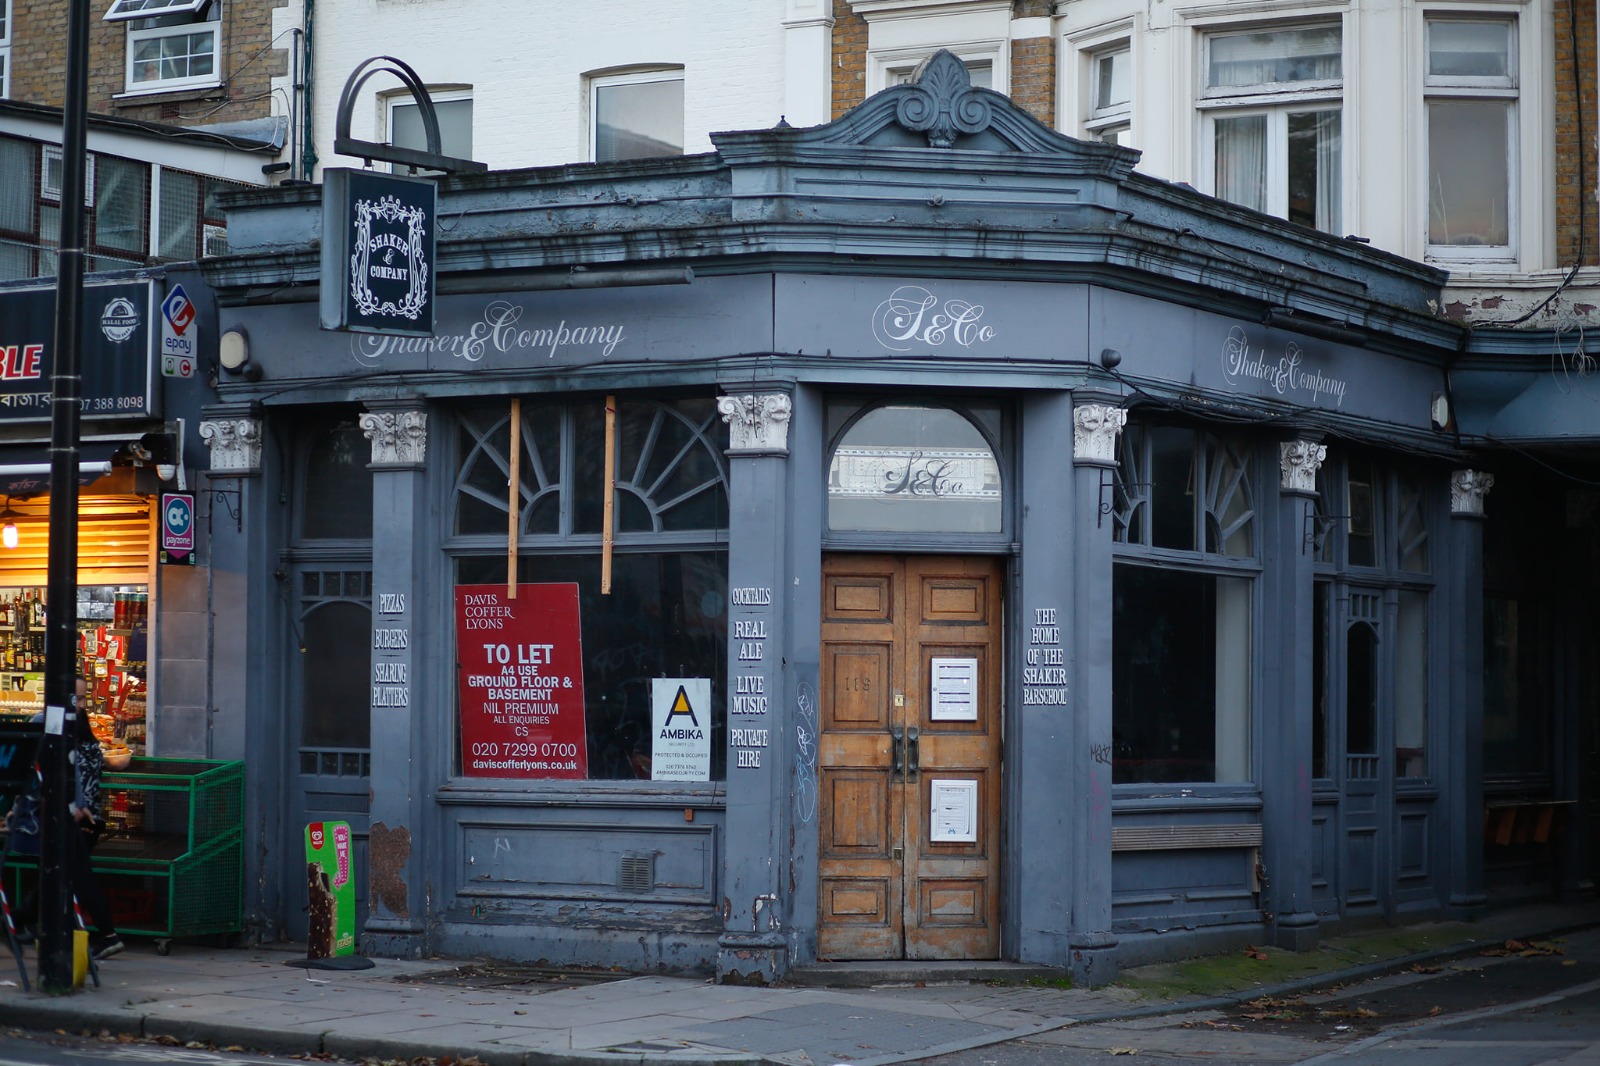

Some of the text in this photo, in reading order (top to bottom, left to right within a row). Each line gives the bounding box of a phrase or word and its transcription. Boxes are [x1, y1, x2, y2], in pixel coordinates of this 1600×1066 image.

[369, 233, 409, 256] SHAKER
[382, 249, 394, 265] &
[370, 265, 408, 280] COMPANY
[165, 337, 192, 354] epay
[94, 398, 114, 410] 388
[117, 396, 144, 409] 8098
[166, 537, 191, 546] payzone
[379, 594, 405, 613] PIZZAS
[465, 594, 498, 606] DAVIS
[732, 588, 770, 605] COCKTAILS
[465, 606, 516, 619] COFFER
[1035, 608, 1056, 625] THE
[466, 618, 503, 630] LYONS
[734, 621, 767, 639] REAL
[374, 629, 408, 649] BURGERS
[1031, 628, 1060, 645] HOME
[483, 644, 554, 664] TO LET
[739, 642, 763, 660] ALE
[1027, 649, 1064, 666] OF THE
[375, 663, 406, 683] SHARING
[501, 665, 538, 676] A4 USE
[1023, 668, 1067, 685] SHAKER
[468, 675, 573, 688] GROUND FLOOR &
[736, 676, 764, 694] LIVE
[372, 687, 409, 707] PLATTERS
[488, 688, 553, 701] BASEMENT
[1023, 688, 1067, 705] BARSCHOOL
[483, 702, 559, 715] NIL PREMIUM
[732, 697, 768, 715] MUSIC
[493, 715, 550, 725] ALL ENQUIRIES
[515, 726, 529, 737] CS
[660, 729, 704, 740] AMBIKA
[731, 729, 768, 747] PRIVATE
[472, 742, 577, 757] 020 7299 0700
[473, 759, 577, 771] daviscofferlyons.co.uk
[737, 750, 761, 768] HIRE
